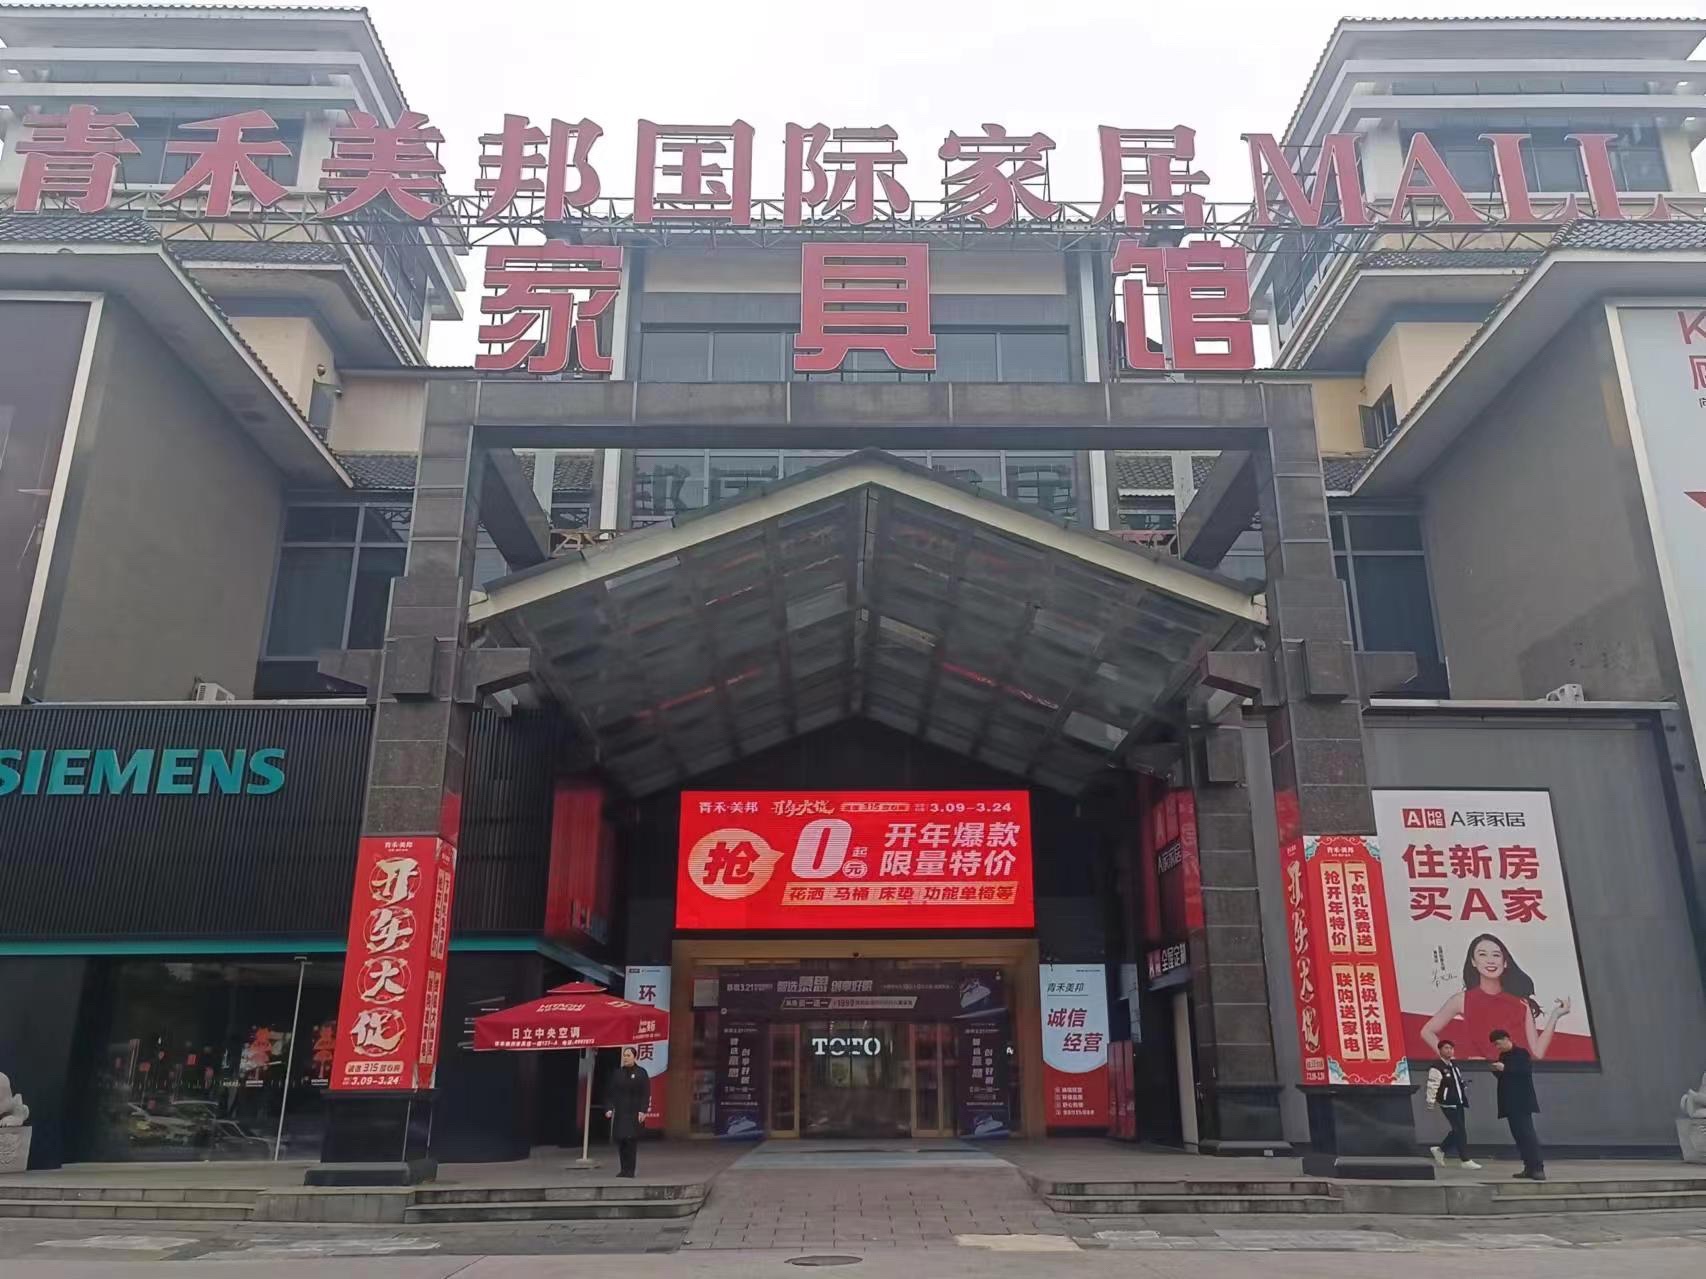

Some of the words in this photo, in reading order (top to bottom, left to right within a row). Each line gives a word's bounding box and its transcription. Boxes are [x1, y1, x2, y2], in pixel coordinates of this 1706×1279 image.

[0, 748, 286, 796] SIEMENS
[791, 818, 852, 879] 0
[884, 822, 1021, 849] 开年爆款
[702, 841, 760, 885] 抢
[879, 850, 1017, 877] 限量特价
[1402, 844, 1540, 880] 住新房
[1324, 870, 1348, 947] 抢开年特价
[1409, 886, 1548, 924] 买A家
[1047, 1008, 1088, 1028] 诚信
[1335, 972, 1360, 1053] 联购送家电
[1360, 971, 1385, 1052] 终极大抽奖
[1062, 1032, 1104, 1053] 经营
